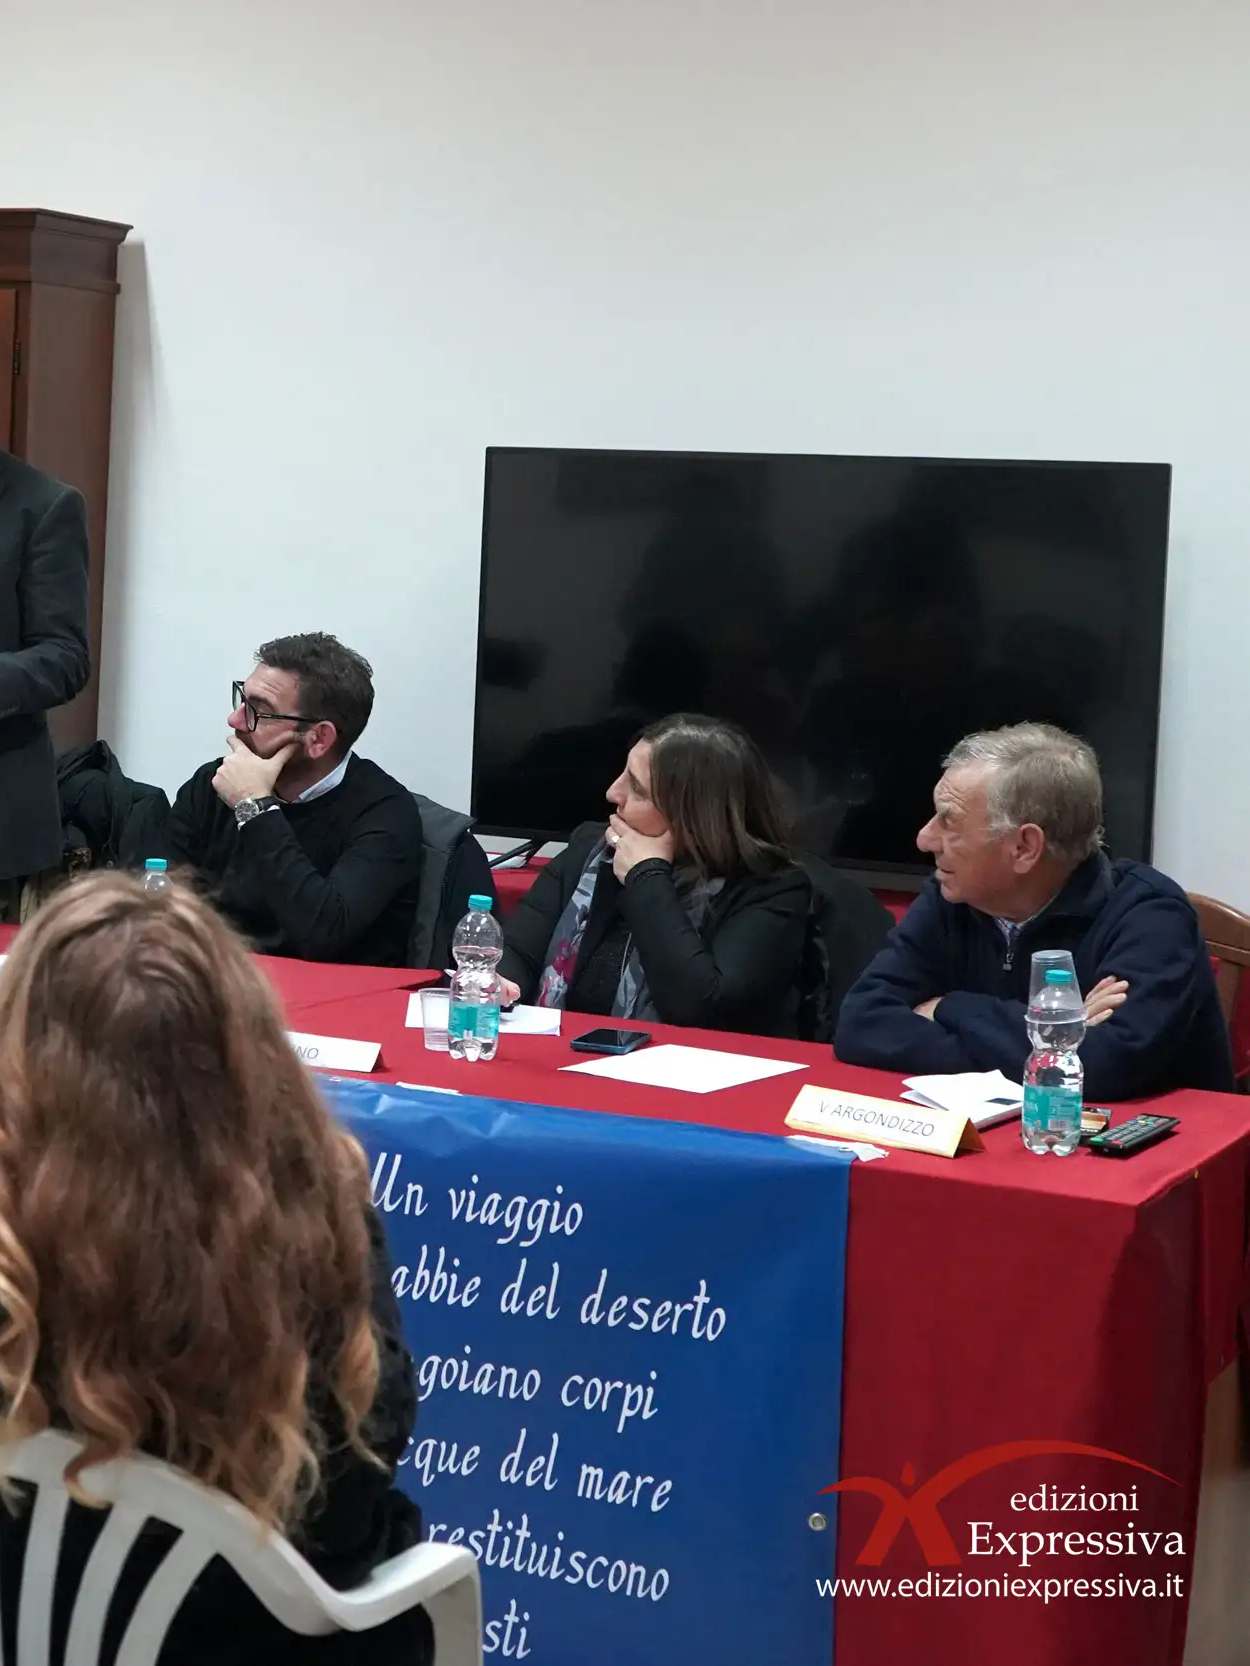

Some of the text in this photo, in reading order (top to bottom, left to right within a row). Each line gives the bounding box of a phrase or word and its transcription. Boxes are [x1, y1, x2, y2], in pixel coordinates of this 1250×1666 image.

[294, 1045, 319, 1060] NO
[831, 1104, 935, 1137] ARGONDIZZO
[371, 1152, 583, 1248] Un viaggio
[391, 1244, 727, 1342] abbie del deserto
[412, 1344, 658, 1434] goiano corpi
[397, 1427, 673, 1512] que del mare
[428, 1508, 670, 1602] restituiscono
[482, 1598, 531, 1660] sti
